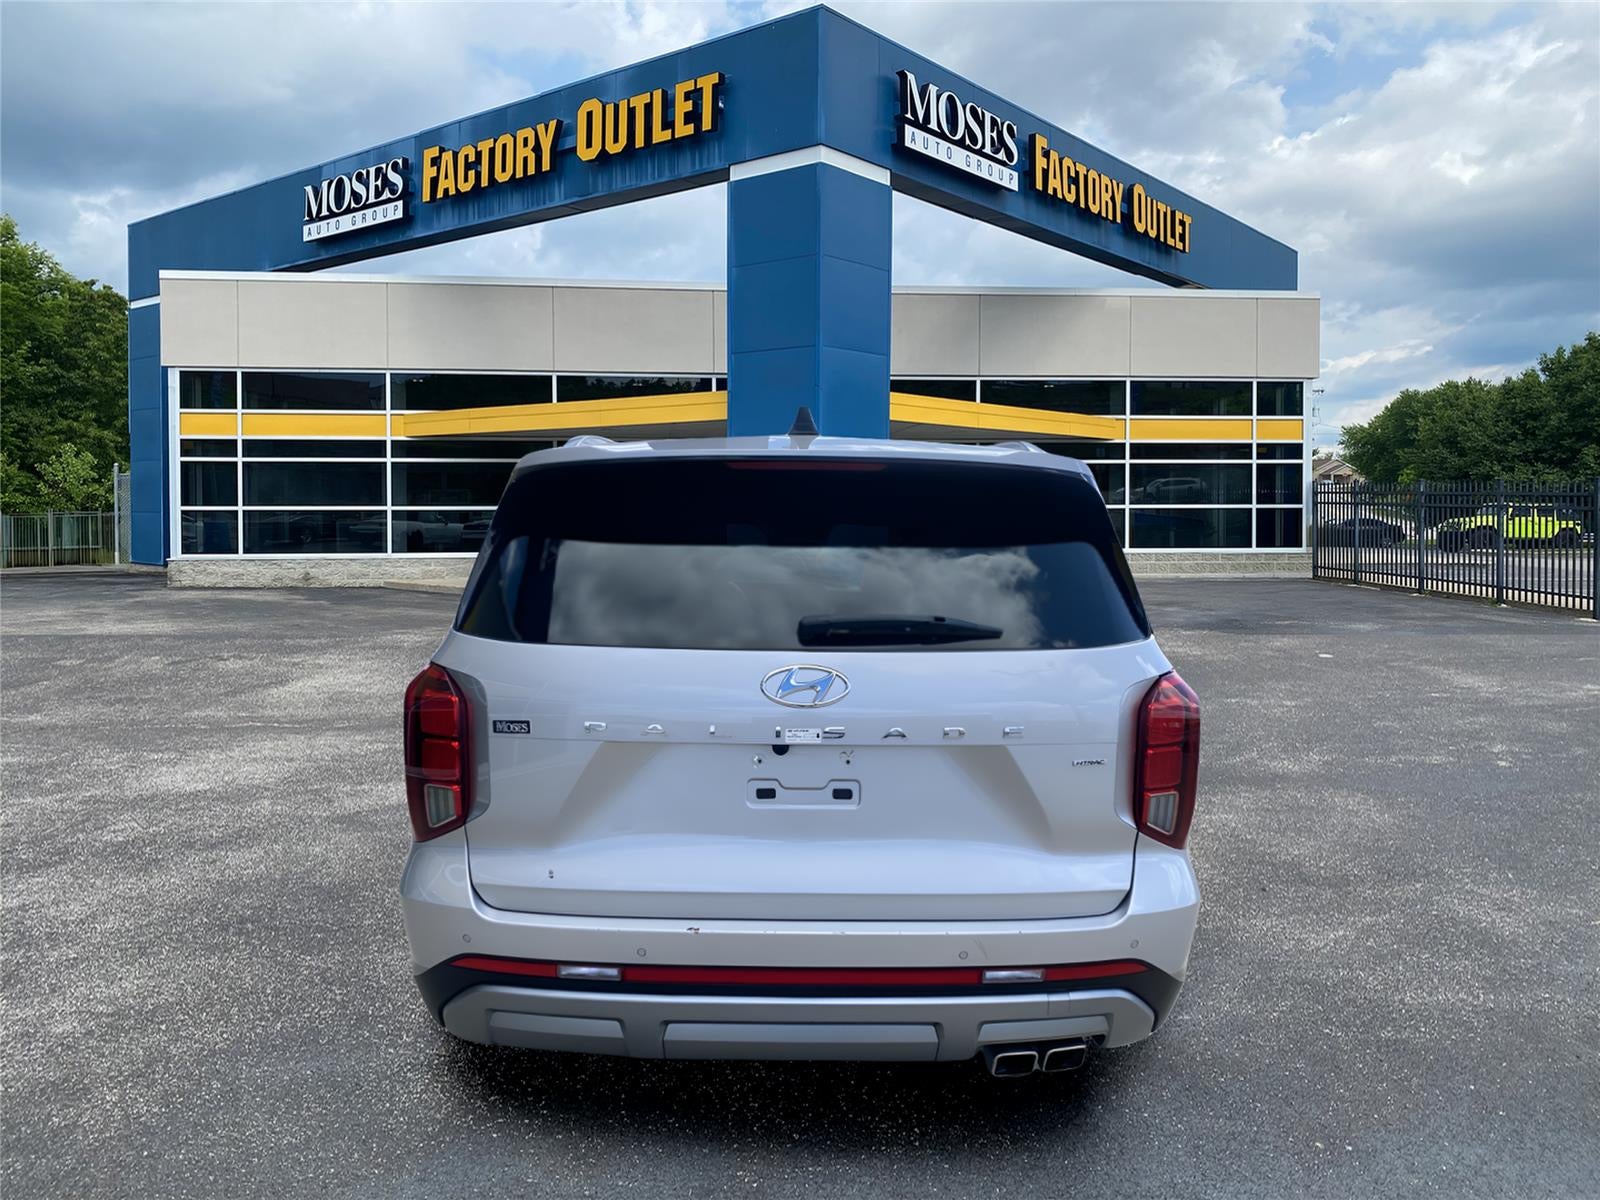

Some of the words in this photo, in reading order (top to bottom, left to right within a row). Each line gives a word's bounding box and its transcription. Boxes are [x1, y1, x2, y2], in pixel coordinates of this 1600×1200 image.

[421, 119, 558, 202] FACTORY
[576, 72, 721, 161] OUTLET
[904, 70, 1019, 166] MOSES
[909, 130, 953, 160] AUTO
[965, 154, 1015, 183] GROUP
[303, 157, 404, 221] MOSES
[306, 219, 341, 238] AUTO
[351, 204, 400, 227] GROUP
[1034, 133, 1124, 224] FACTORY
[1132, 183, 1192, 254] OUTLET
